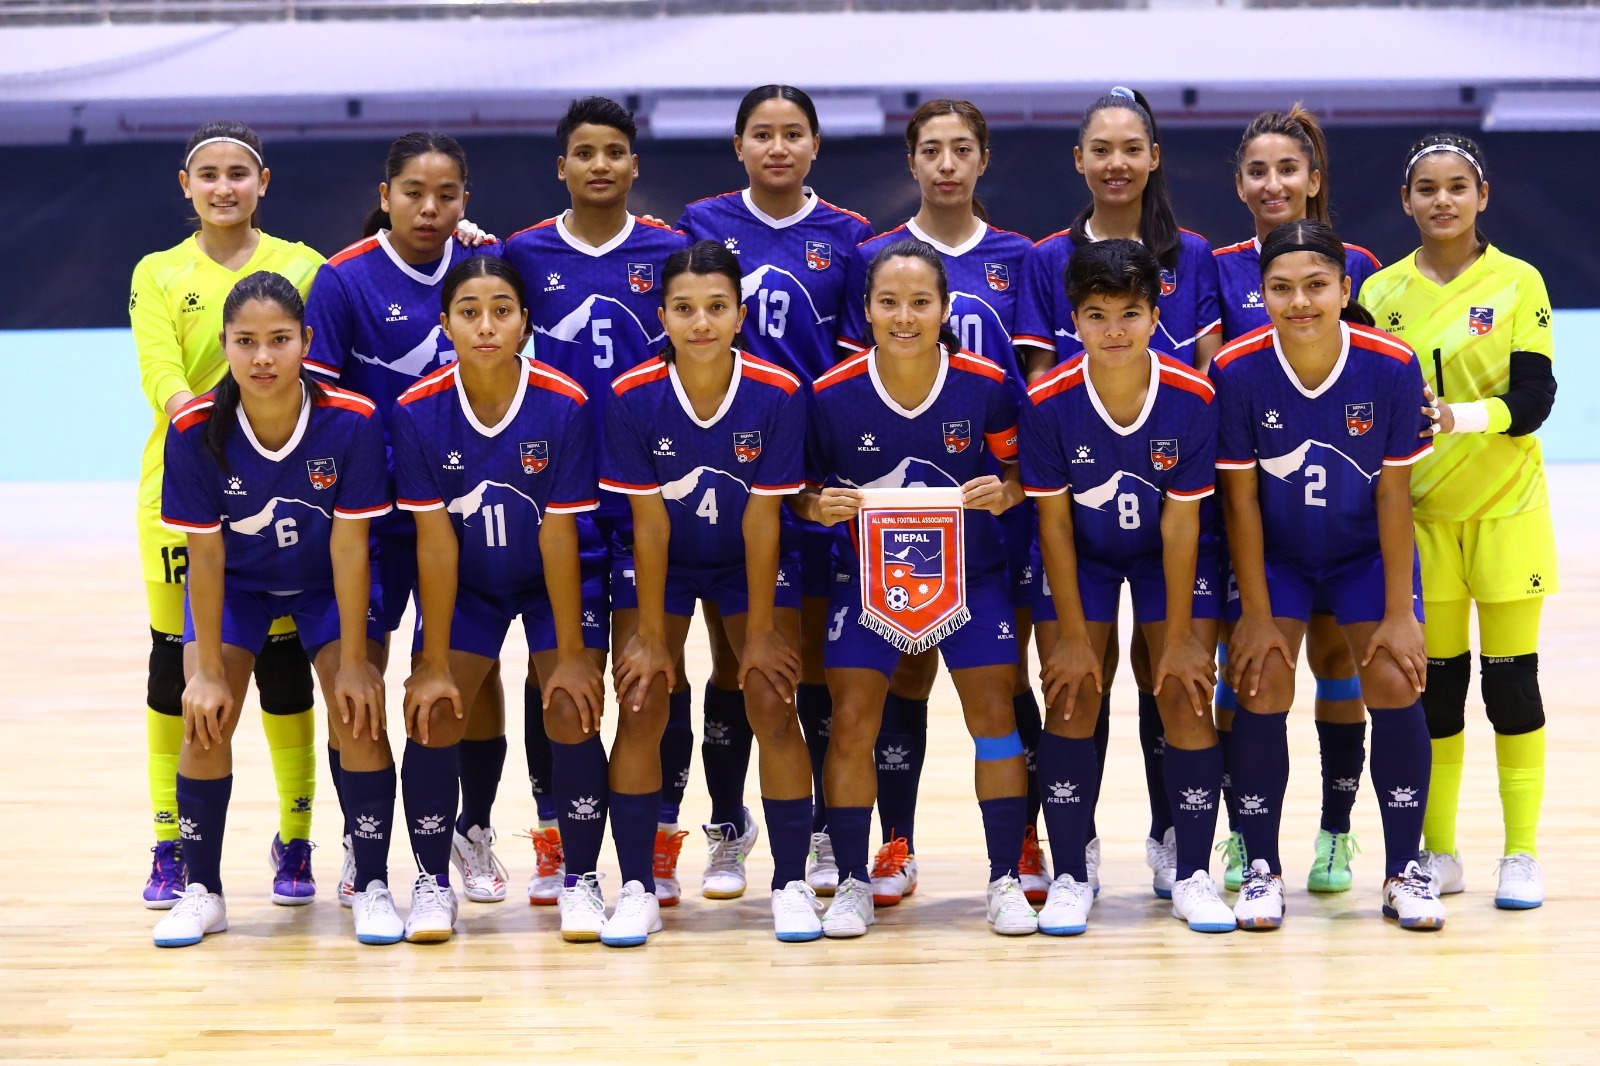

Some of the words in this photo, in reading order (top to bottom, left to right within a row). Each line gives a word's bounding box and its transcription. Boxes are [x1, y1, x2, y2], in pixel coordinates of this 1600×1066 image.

[758, 288, 790, 339] 13
[592, 318, 614, 368] 5
[950, 314, 982, 356] 10
[1433, 348, 1444, 397] 1
[1305, 464, 1327, 507] 2
[482, 503, 507, 546] 11
[695, 488, 718, 525] 4
[1117, 492, 1140, 529] 8
[275, 517, 298, 548] 6
[894, 534, 930, 542] NEPAL
[161, 546, 189, 584] 12
[828, 607, 849, 641] 3
[568, 812, 601, 820] KELME
[1180, 803, 1212, 811] KELME
[354, 830, 383, 840] KELME
[415, 826, 446, 835] KELME
